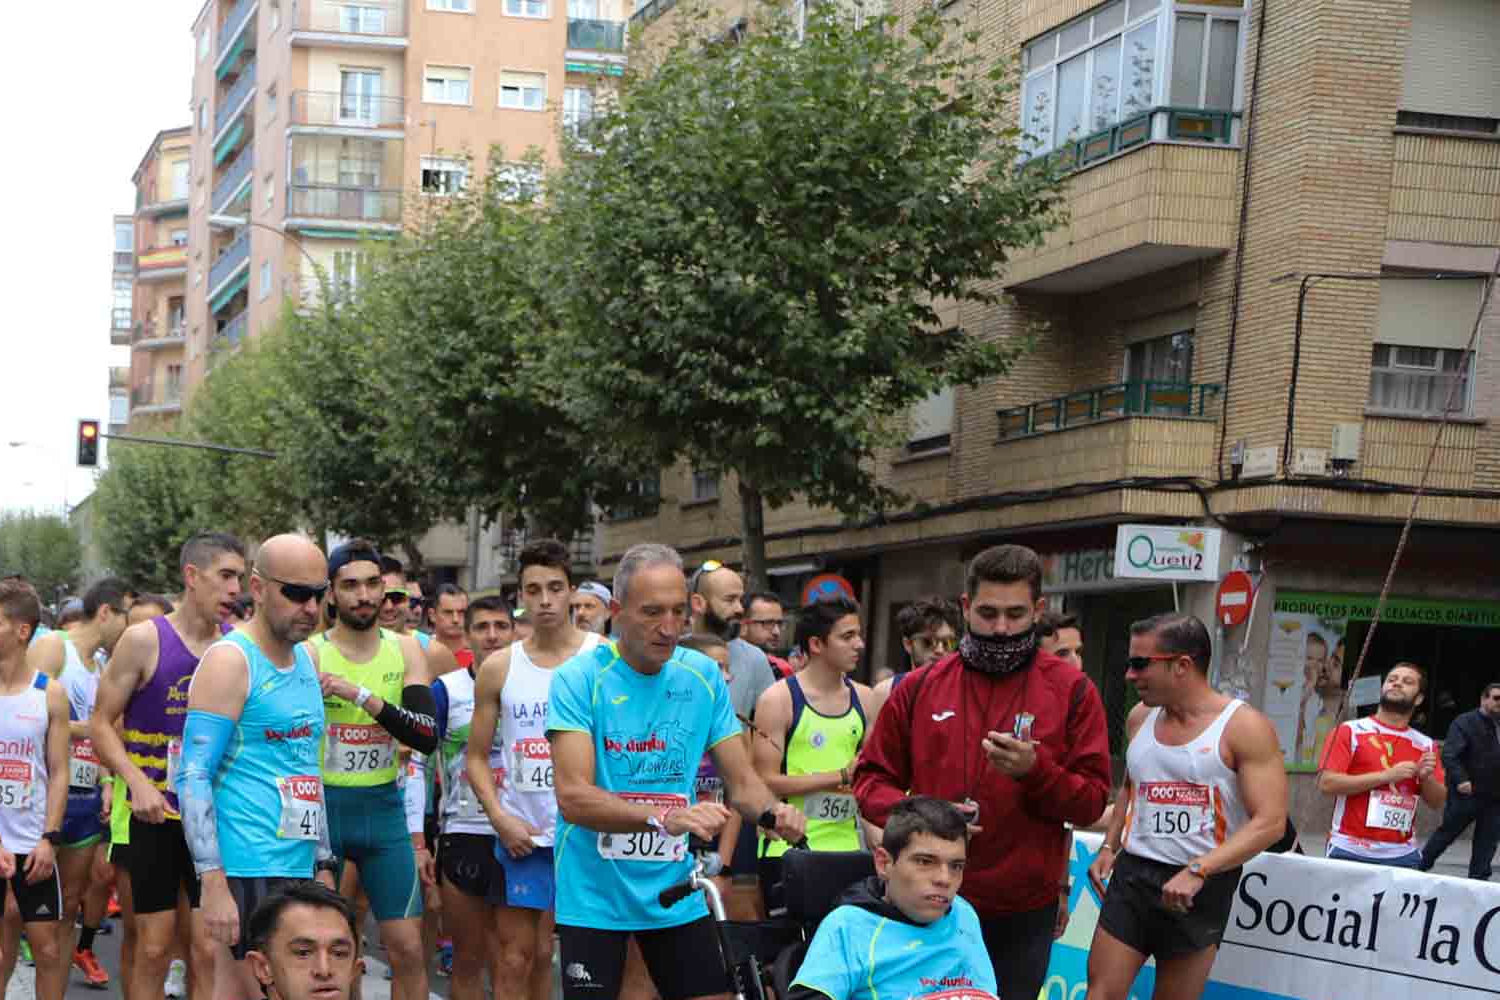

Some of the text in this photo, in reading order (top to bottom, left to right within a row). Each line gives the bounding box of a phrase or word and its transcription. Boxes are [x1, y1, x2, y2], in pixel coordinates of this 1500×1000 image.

[1274, 600, 1347, 617] PRODUCTOS
[513, 703, 528, 719] LA
[344, 749, 380, 771] 378
[820, 796, 850, 818] 364
[1153, 811, 1190, 834] 150
[1382, 810, 1407, 829] 584
[622, 832, 666, 857] 302
[1235, 872, 1386, 952] Social
